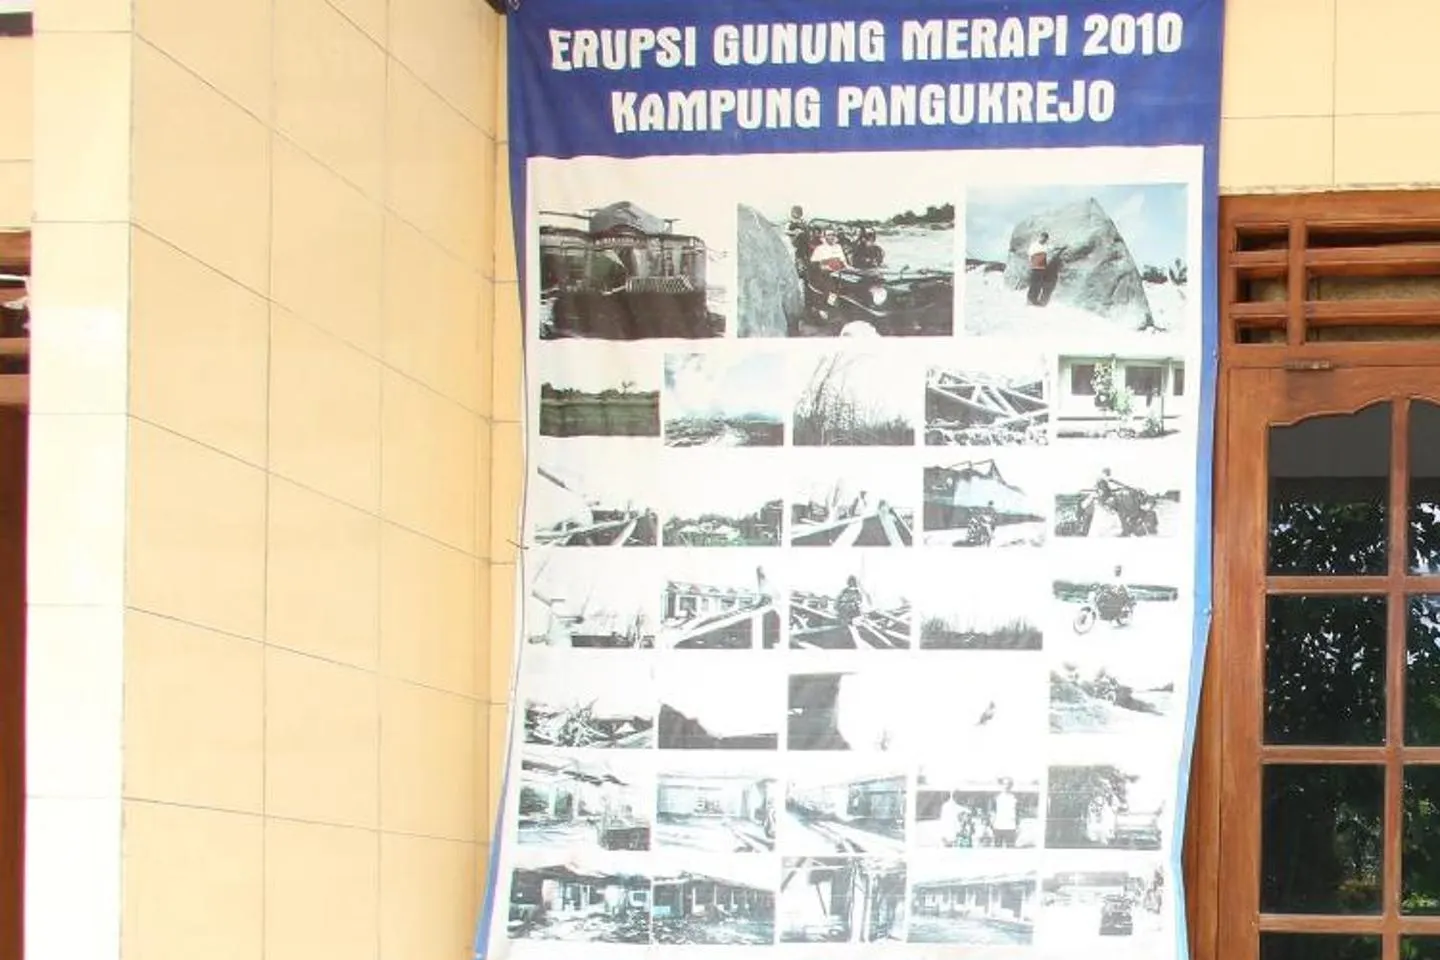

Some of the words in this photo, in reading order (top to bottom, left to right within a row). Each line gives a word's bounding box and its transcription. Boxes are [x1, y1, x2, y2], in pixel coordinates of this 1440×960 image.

[549, 27, 697, 71] ERUPSI
[713, 20, 885, 66] GUNUNG
[902, 15, 1067, 62] MERAPI
[1083, 12, 1184, 57] 2010
[611, 85, 821, 133] KAMPUNG
[837, 79, 1116, 129] PANGUKREJO
